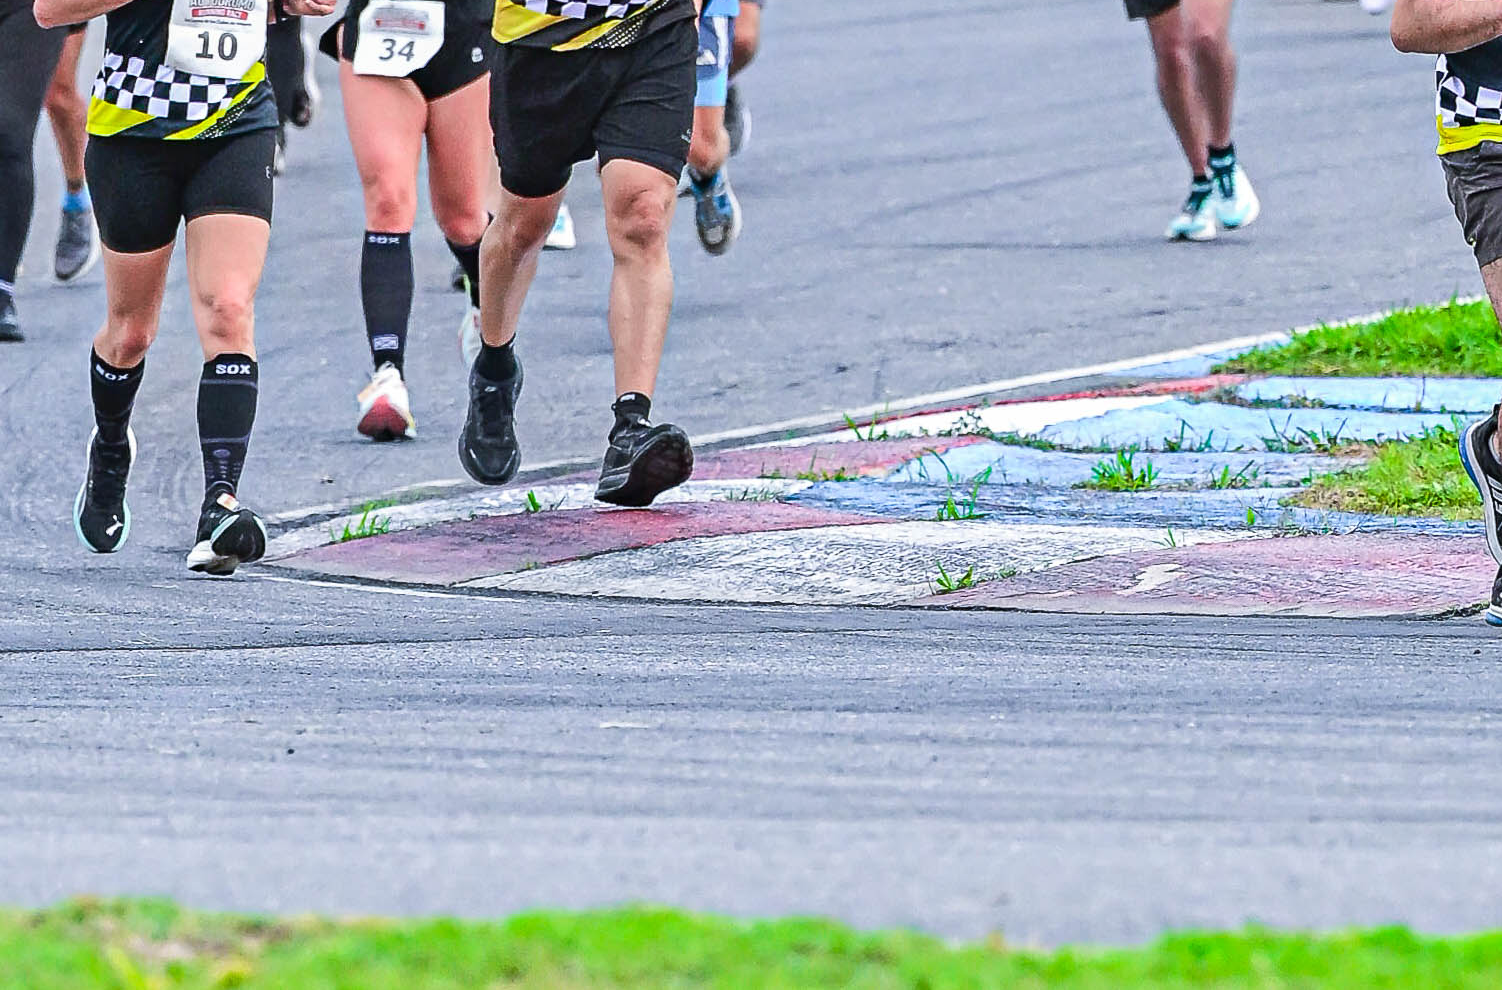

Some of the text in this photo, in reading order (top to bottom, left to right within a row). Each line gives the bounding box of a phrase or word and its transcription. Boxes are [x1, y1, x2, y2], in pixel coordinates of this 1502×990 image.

[195, 30, 238, 61] 10
[378, 38, 416, 62] 34
[215, 363, 251, 375] SOX
